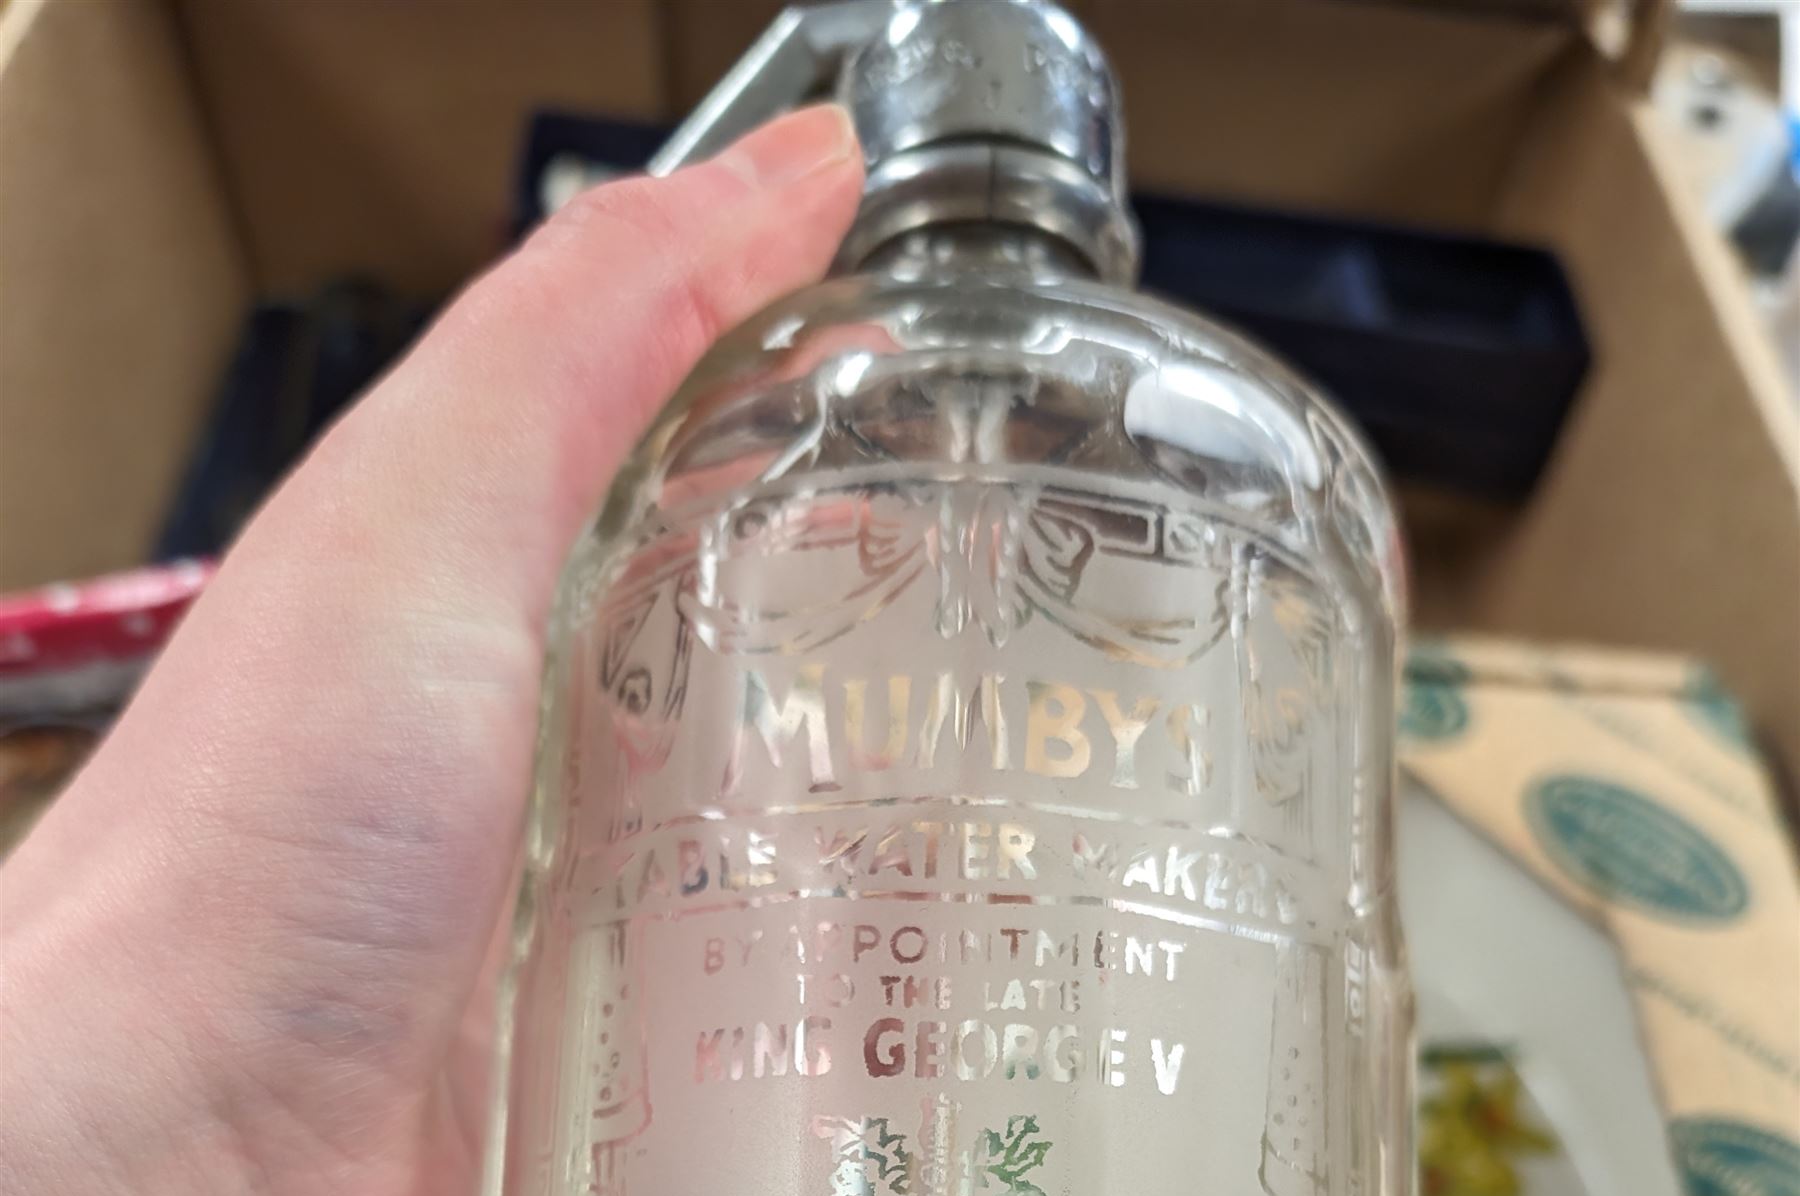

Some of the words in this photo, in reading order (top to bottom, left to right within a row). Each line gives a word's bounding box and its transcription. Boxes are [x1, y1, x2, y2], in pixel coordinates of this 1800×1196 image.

[703, 928, 764, 976] BY
[879, 975, 952, 1010] THE
[983, 978, 1081, 1012] LATE
[693, 1015, 832, 1083] KING
[862, 1017, 1127, 1086] GEORGE
[1150, 1036, 1185, 1096] V
